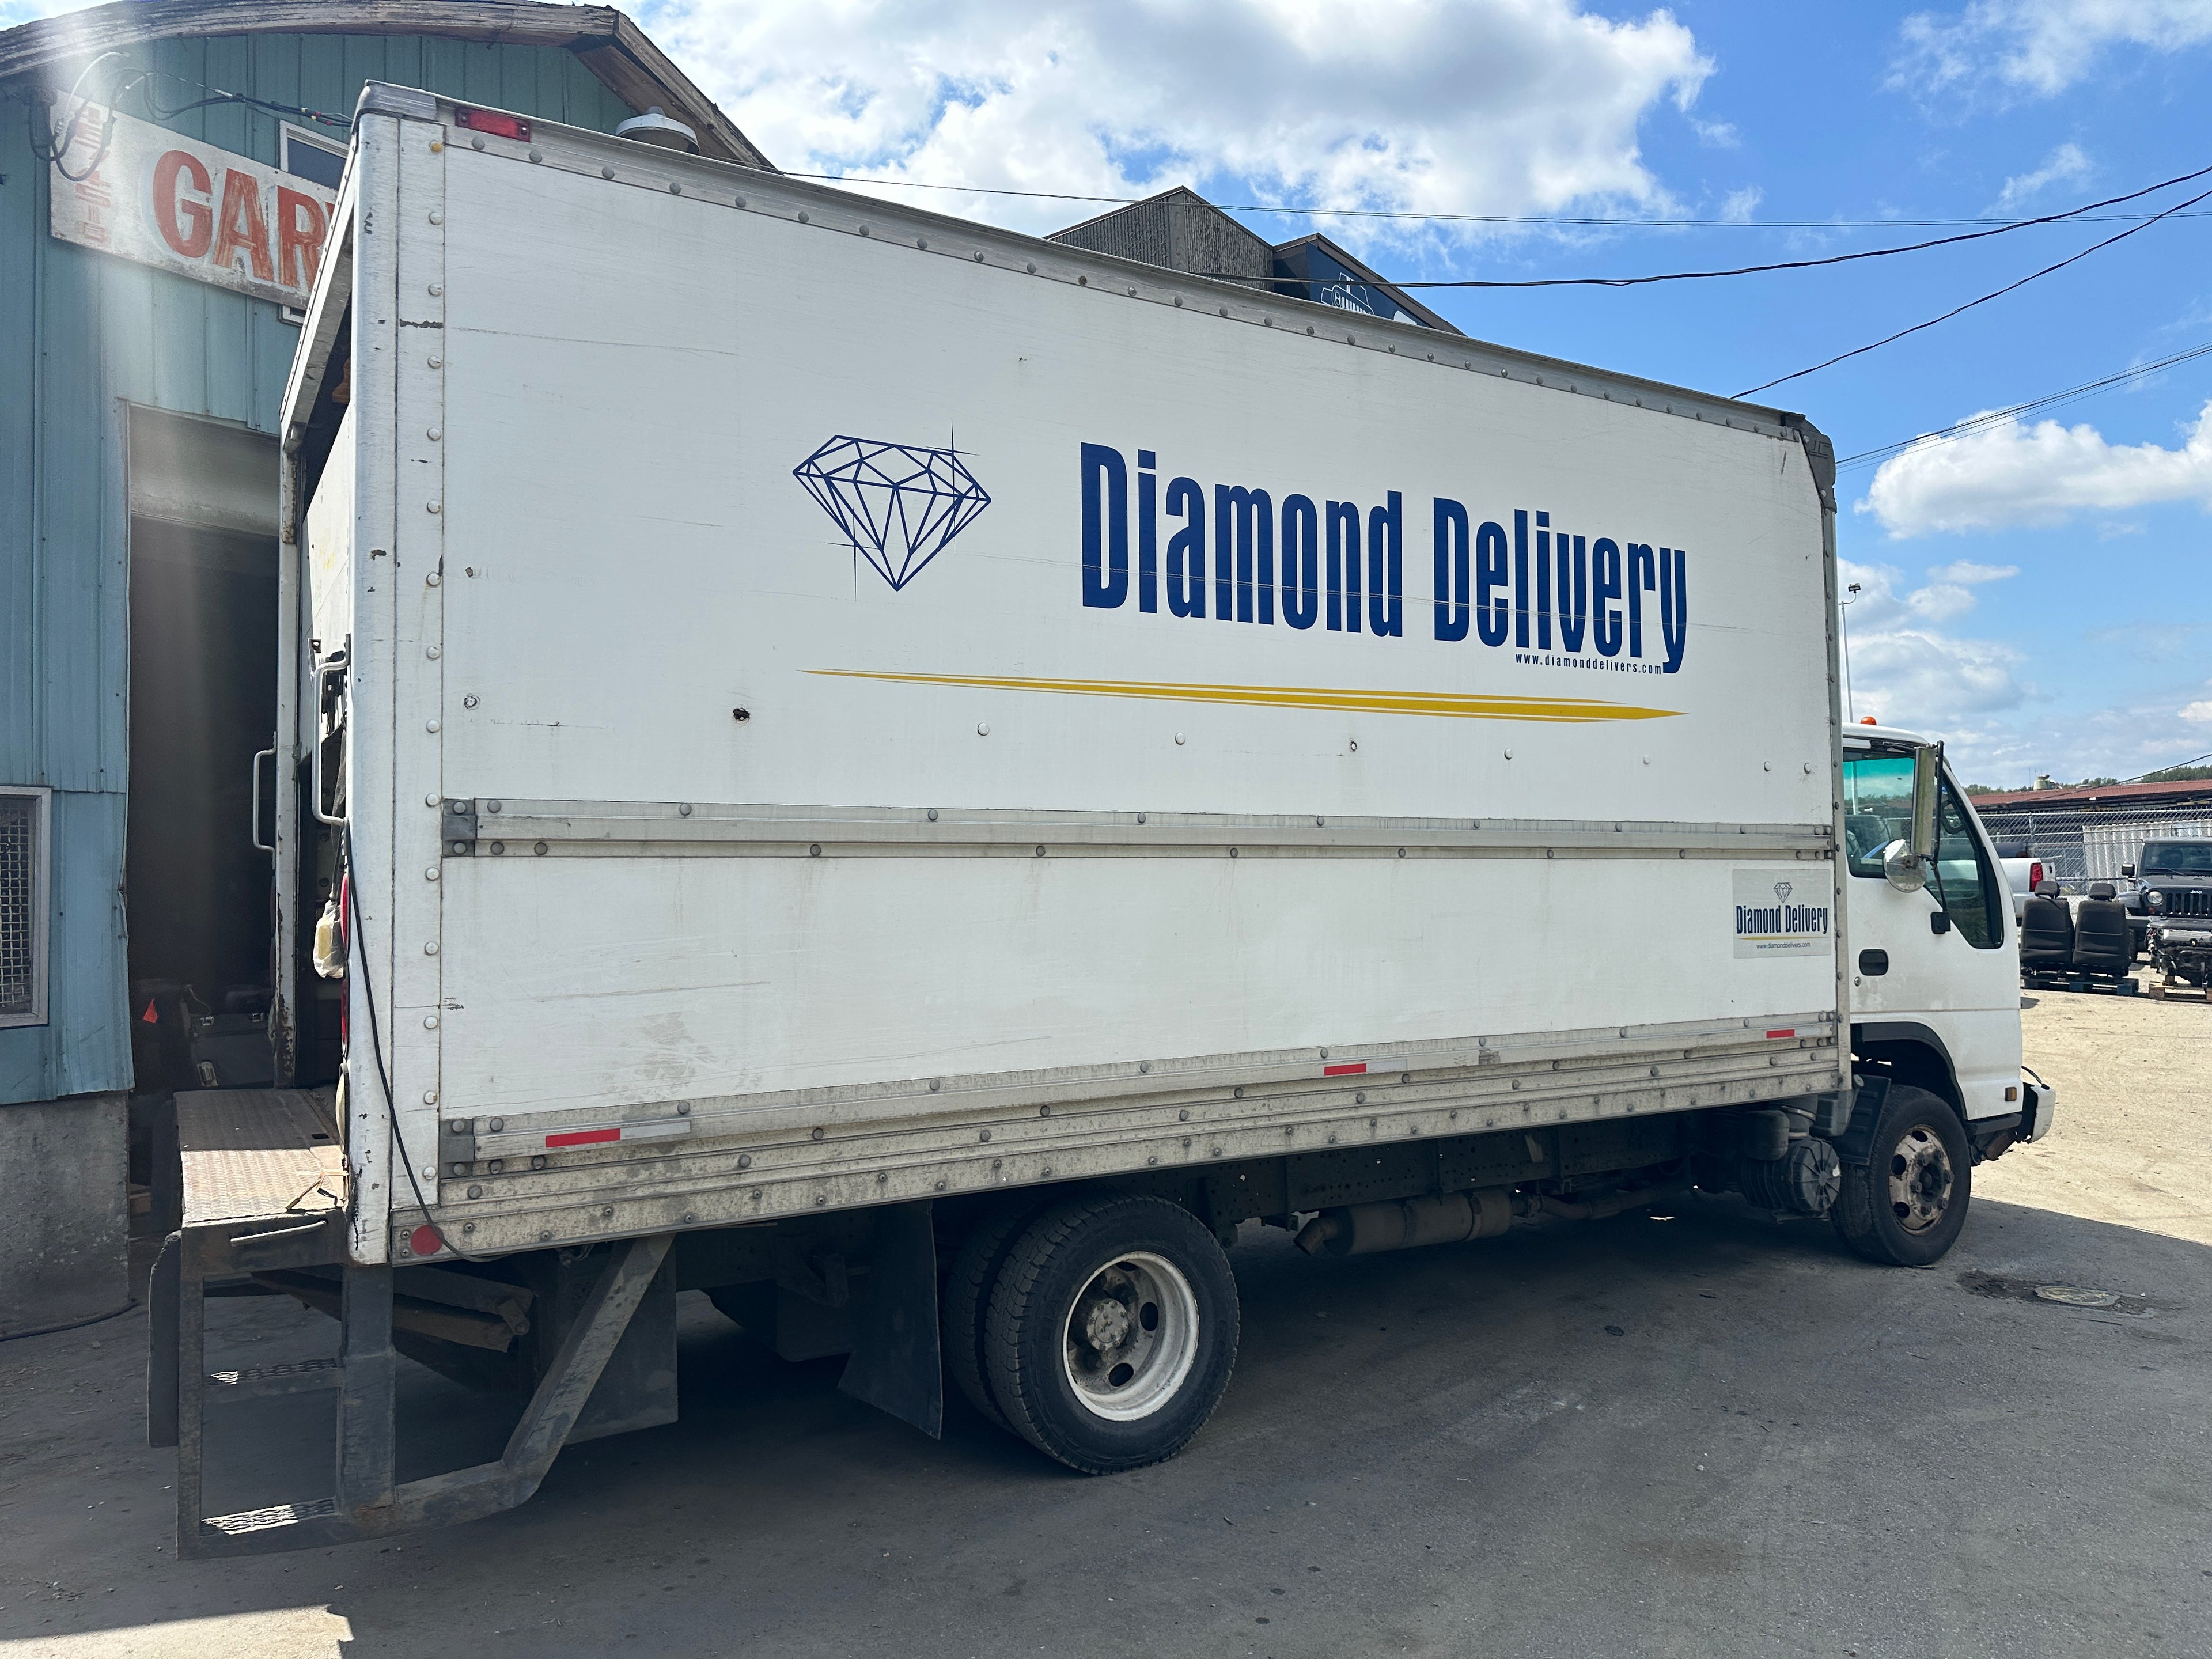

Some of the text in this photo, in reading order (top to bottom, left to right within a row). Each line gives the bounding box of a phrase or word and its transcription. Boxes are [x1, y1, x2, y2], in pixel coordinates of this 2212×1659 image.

[153, 150, 335, 291] GAR
[1081, 442, 1686, 673] Diamond Delivery
[1516, 654, 1661, 675] www.diamonddelivers.com
[1736, 904, 1828, 934] Diamond Delivery
